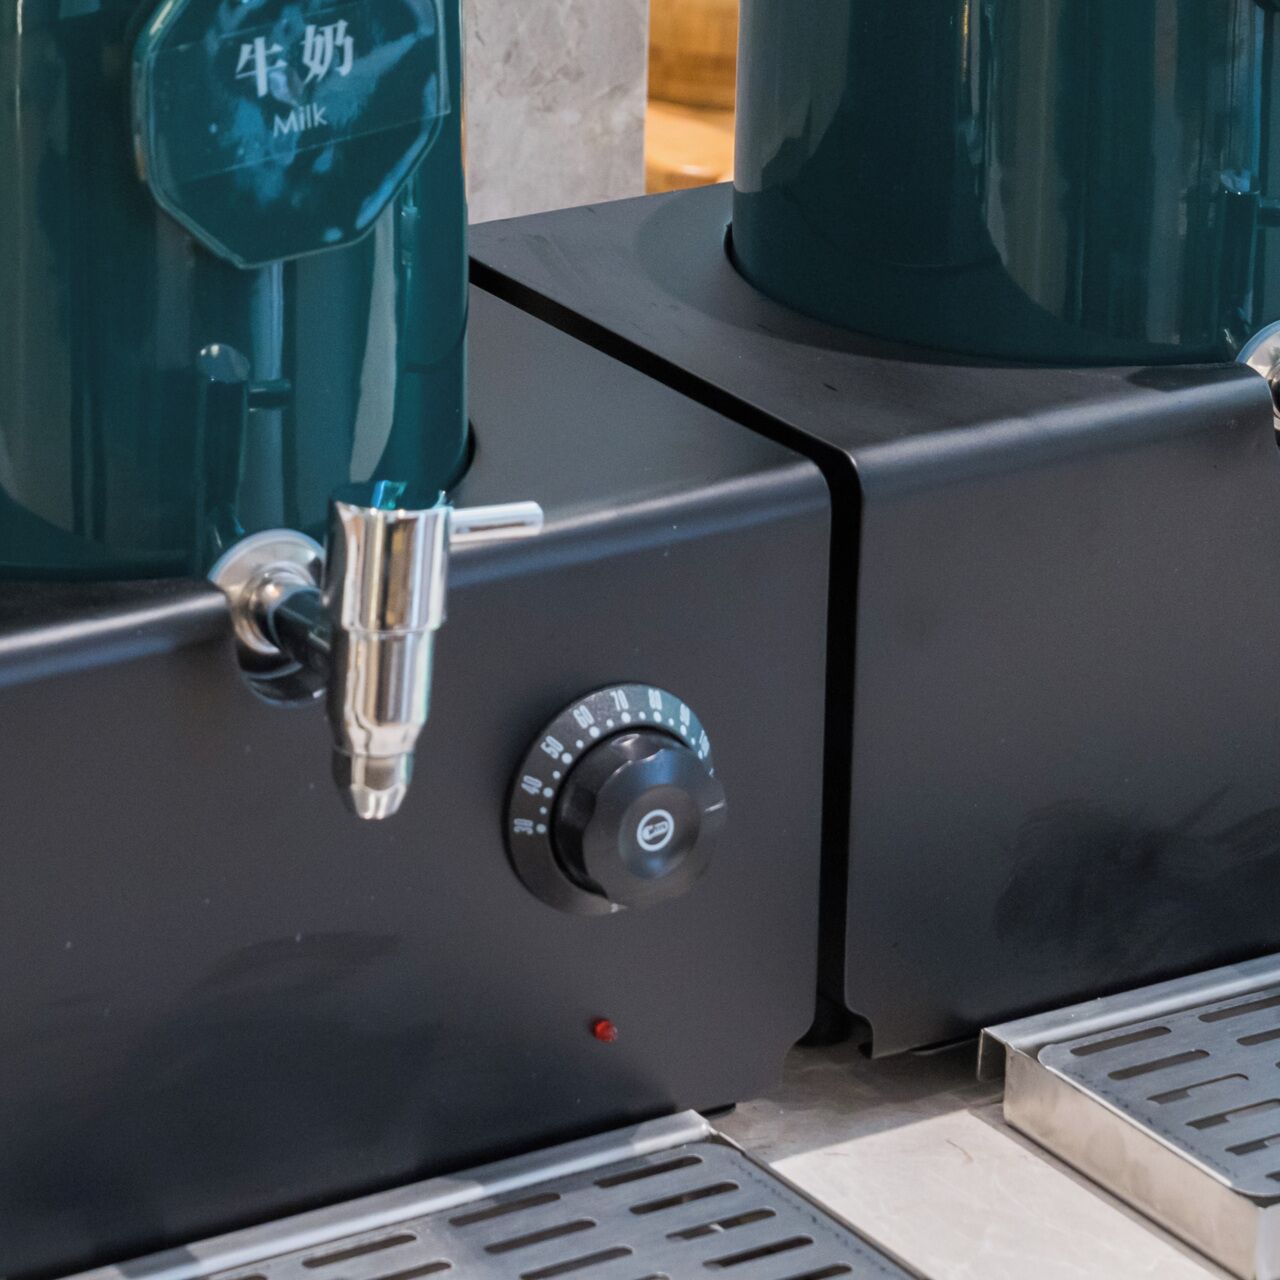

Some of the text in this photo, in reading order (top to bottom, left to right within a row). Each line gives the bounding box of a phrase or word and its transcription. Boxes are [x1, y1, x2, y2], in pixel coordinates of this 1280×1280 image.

[235, 19, 355, 98] 牛奶
[273, 103, 327, 137] Milk
[610, 689, 629, 711] 70
[573, 704, 594, 729] 60
[540, 735, 564, 759] 50
[521, 775, 542, 795] 40
[513, 818, 533, 835] 30
